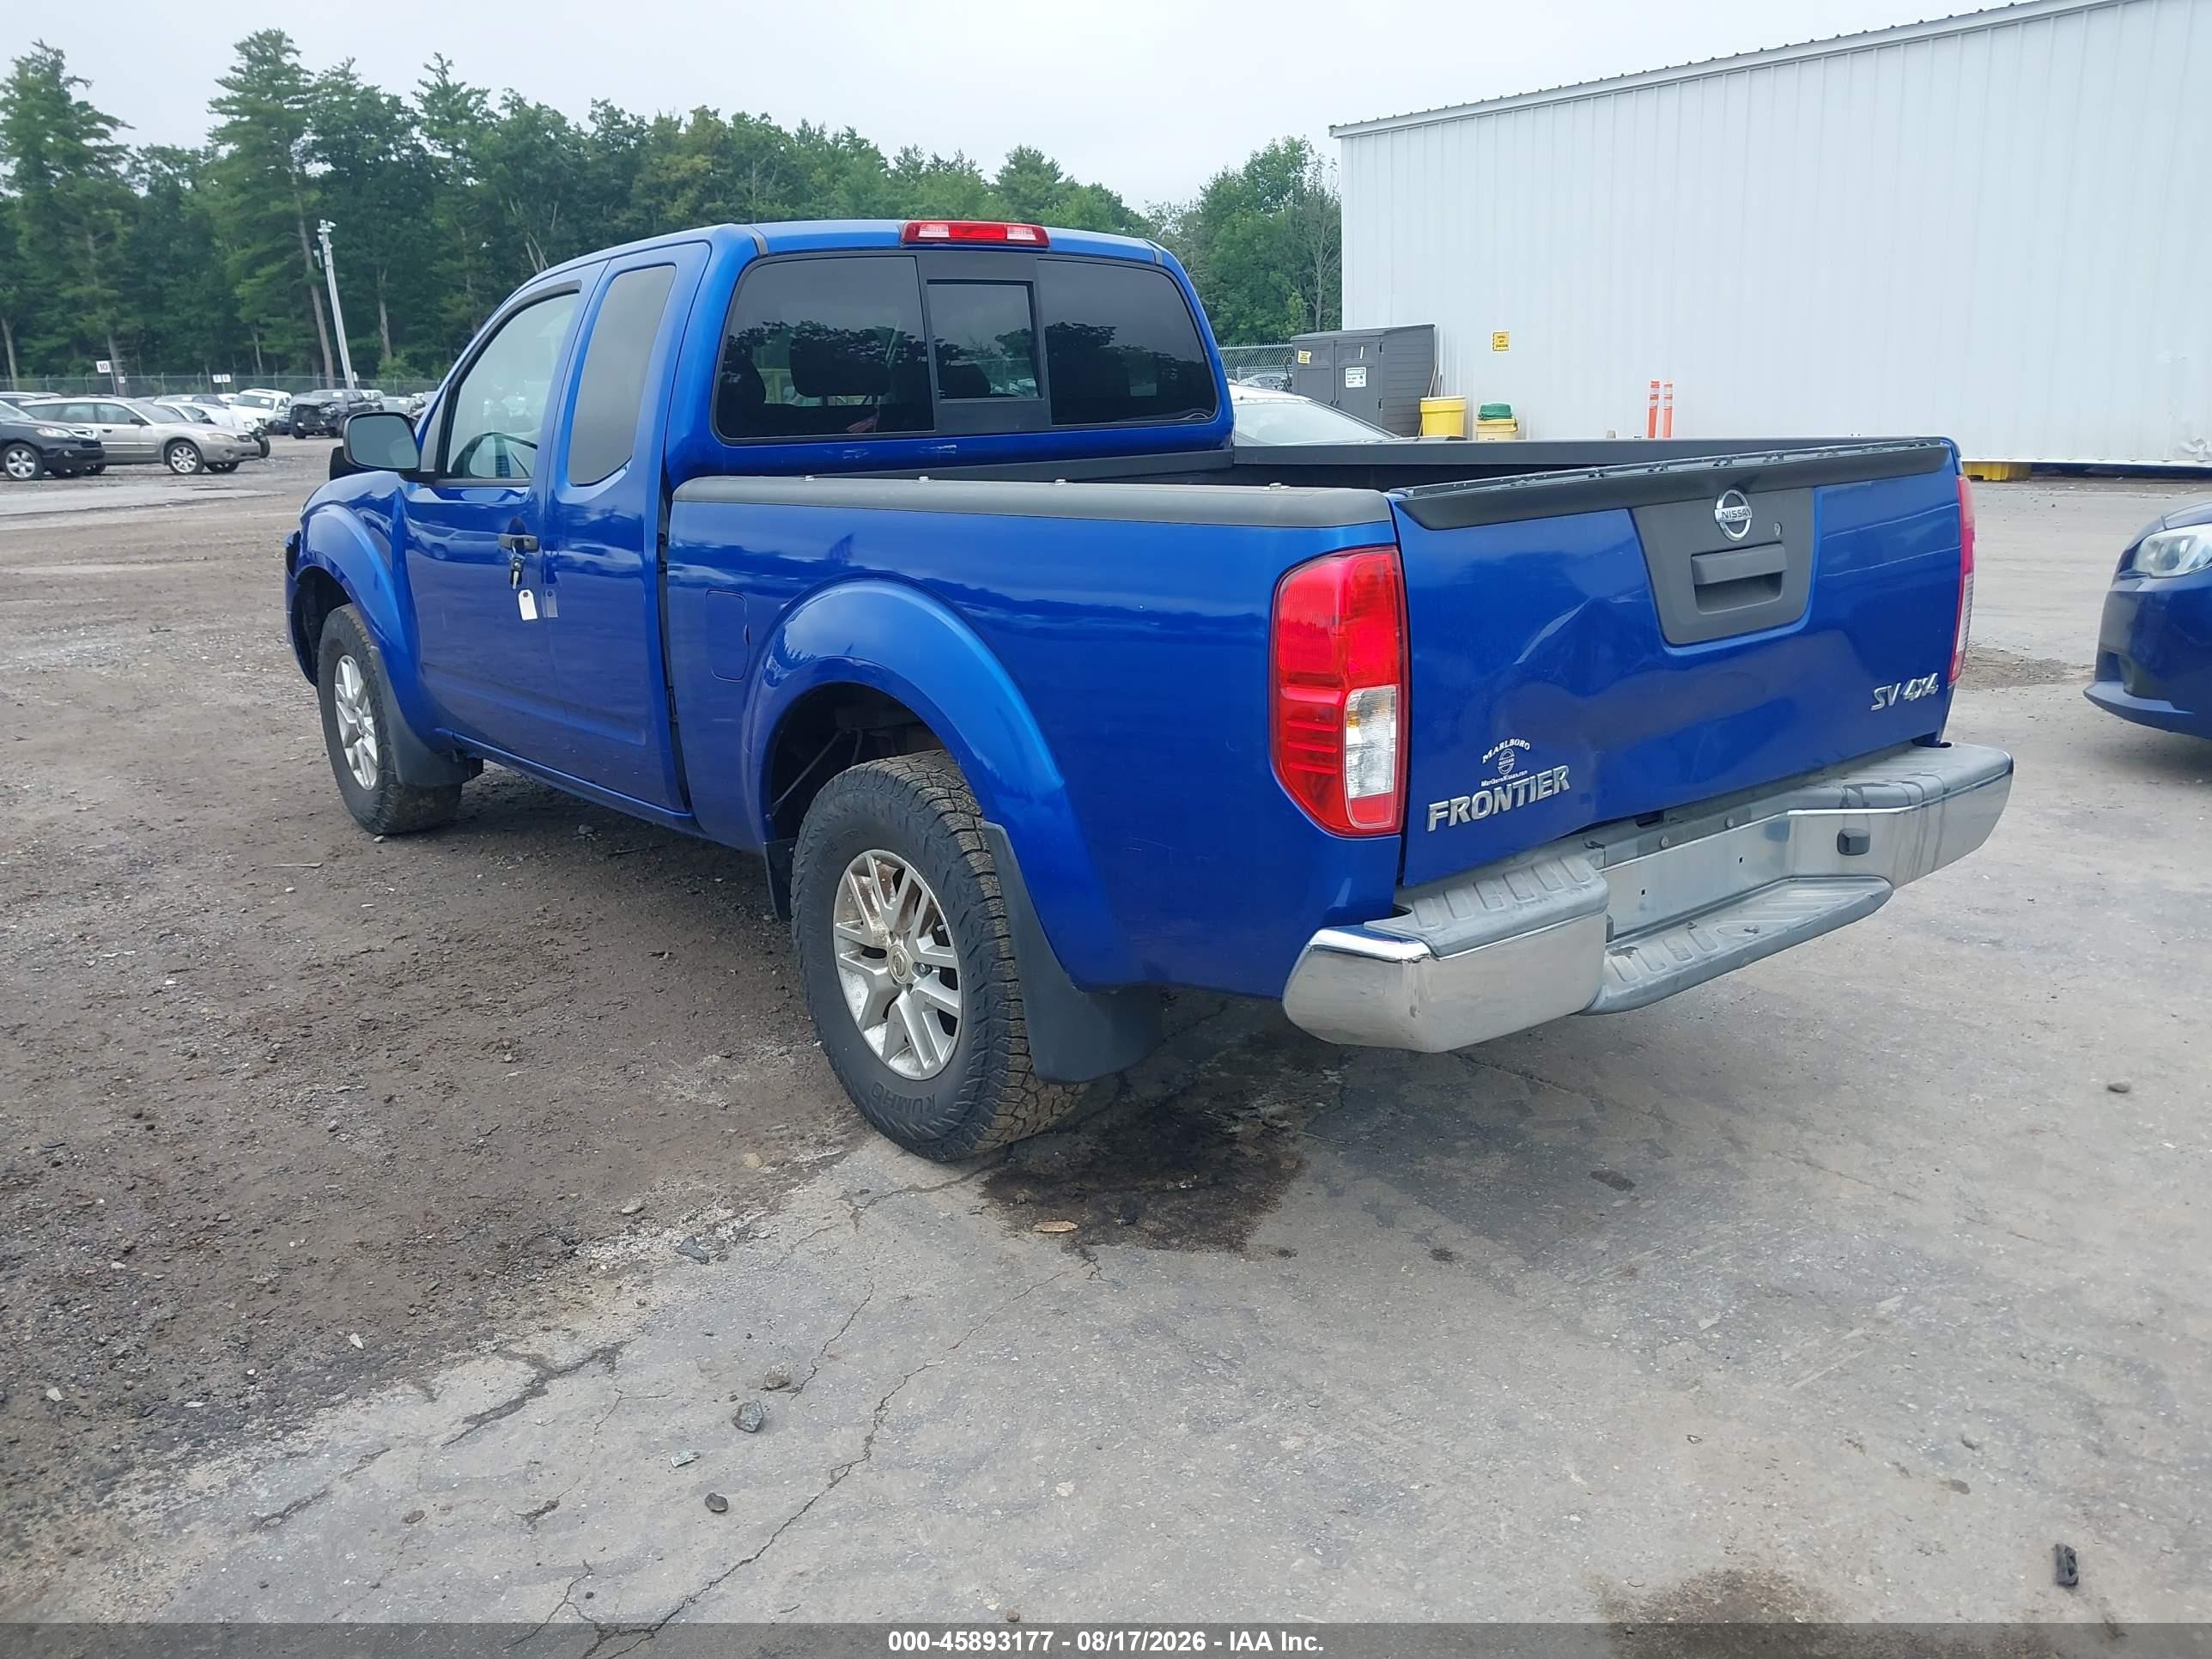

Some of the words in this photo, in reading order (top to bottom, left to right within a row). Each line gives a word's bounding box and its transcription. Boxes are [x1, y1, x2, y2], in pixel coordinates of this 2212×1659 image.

[100, 362, 108, 372] 10
[1721, 507, 1751, 520] NISSAN
[1870, 683, 1901, 711] SV
[1482, 738, 1530, 763] MARLBORO
[1427, 765, 1571, 831] FRONTIER
[870, 1080, 937, 1114] KUMHO
